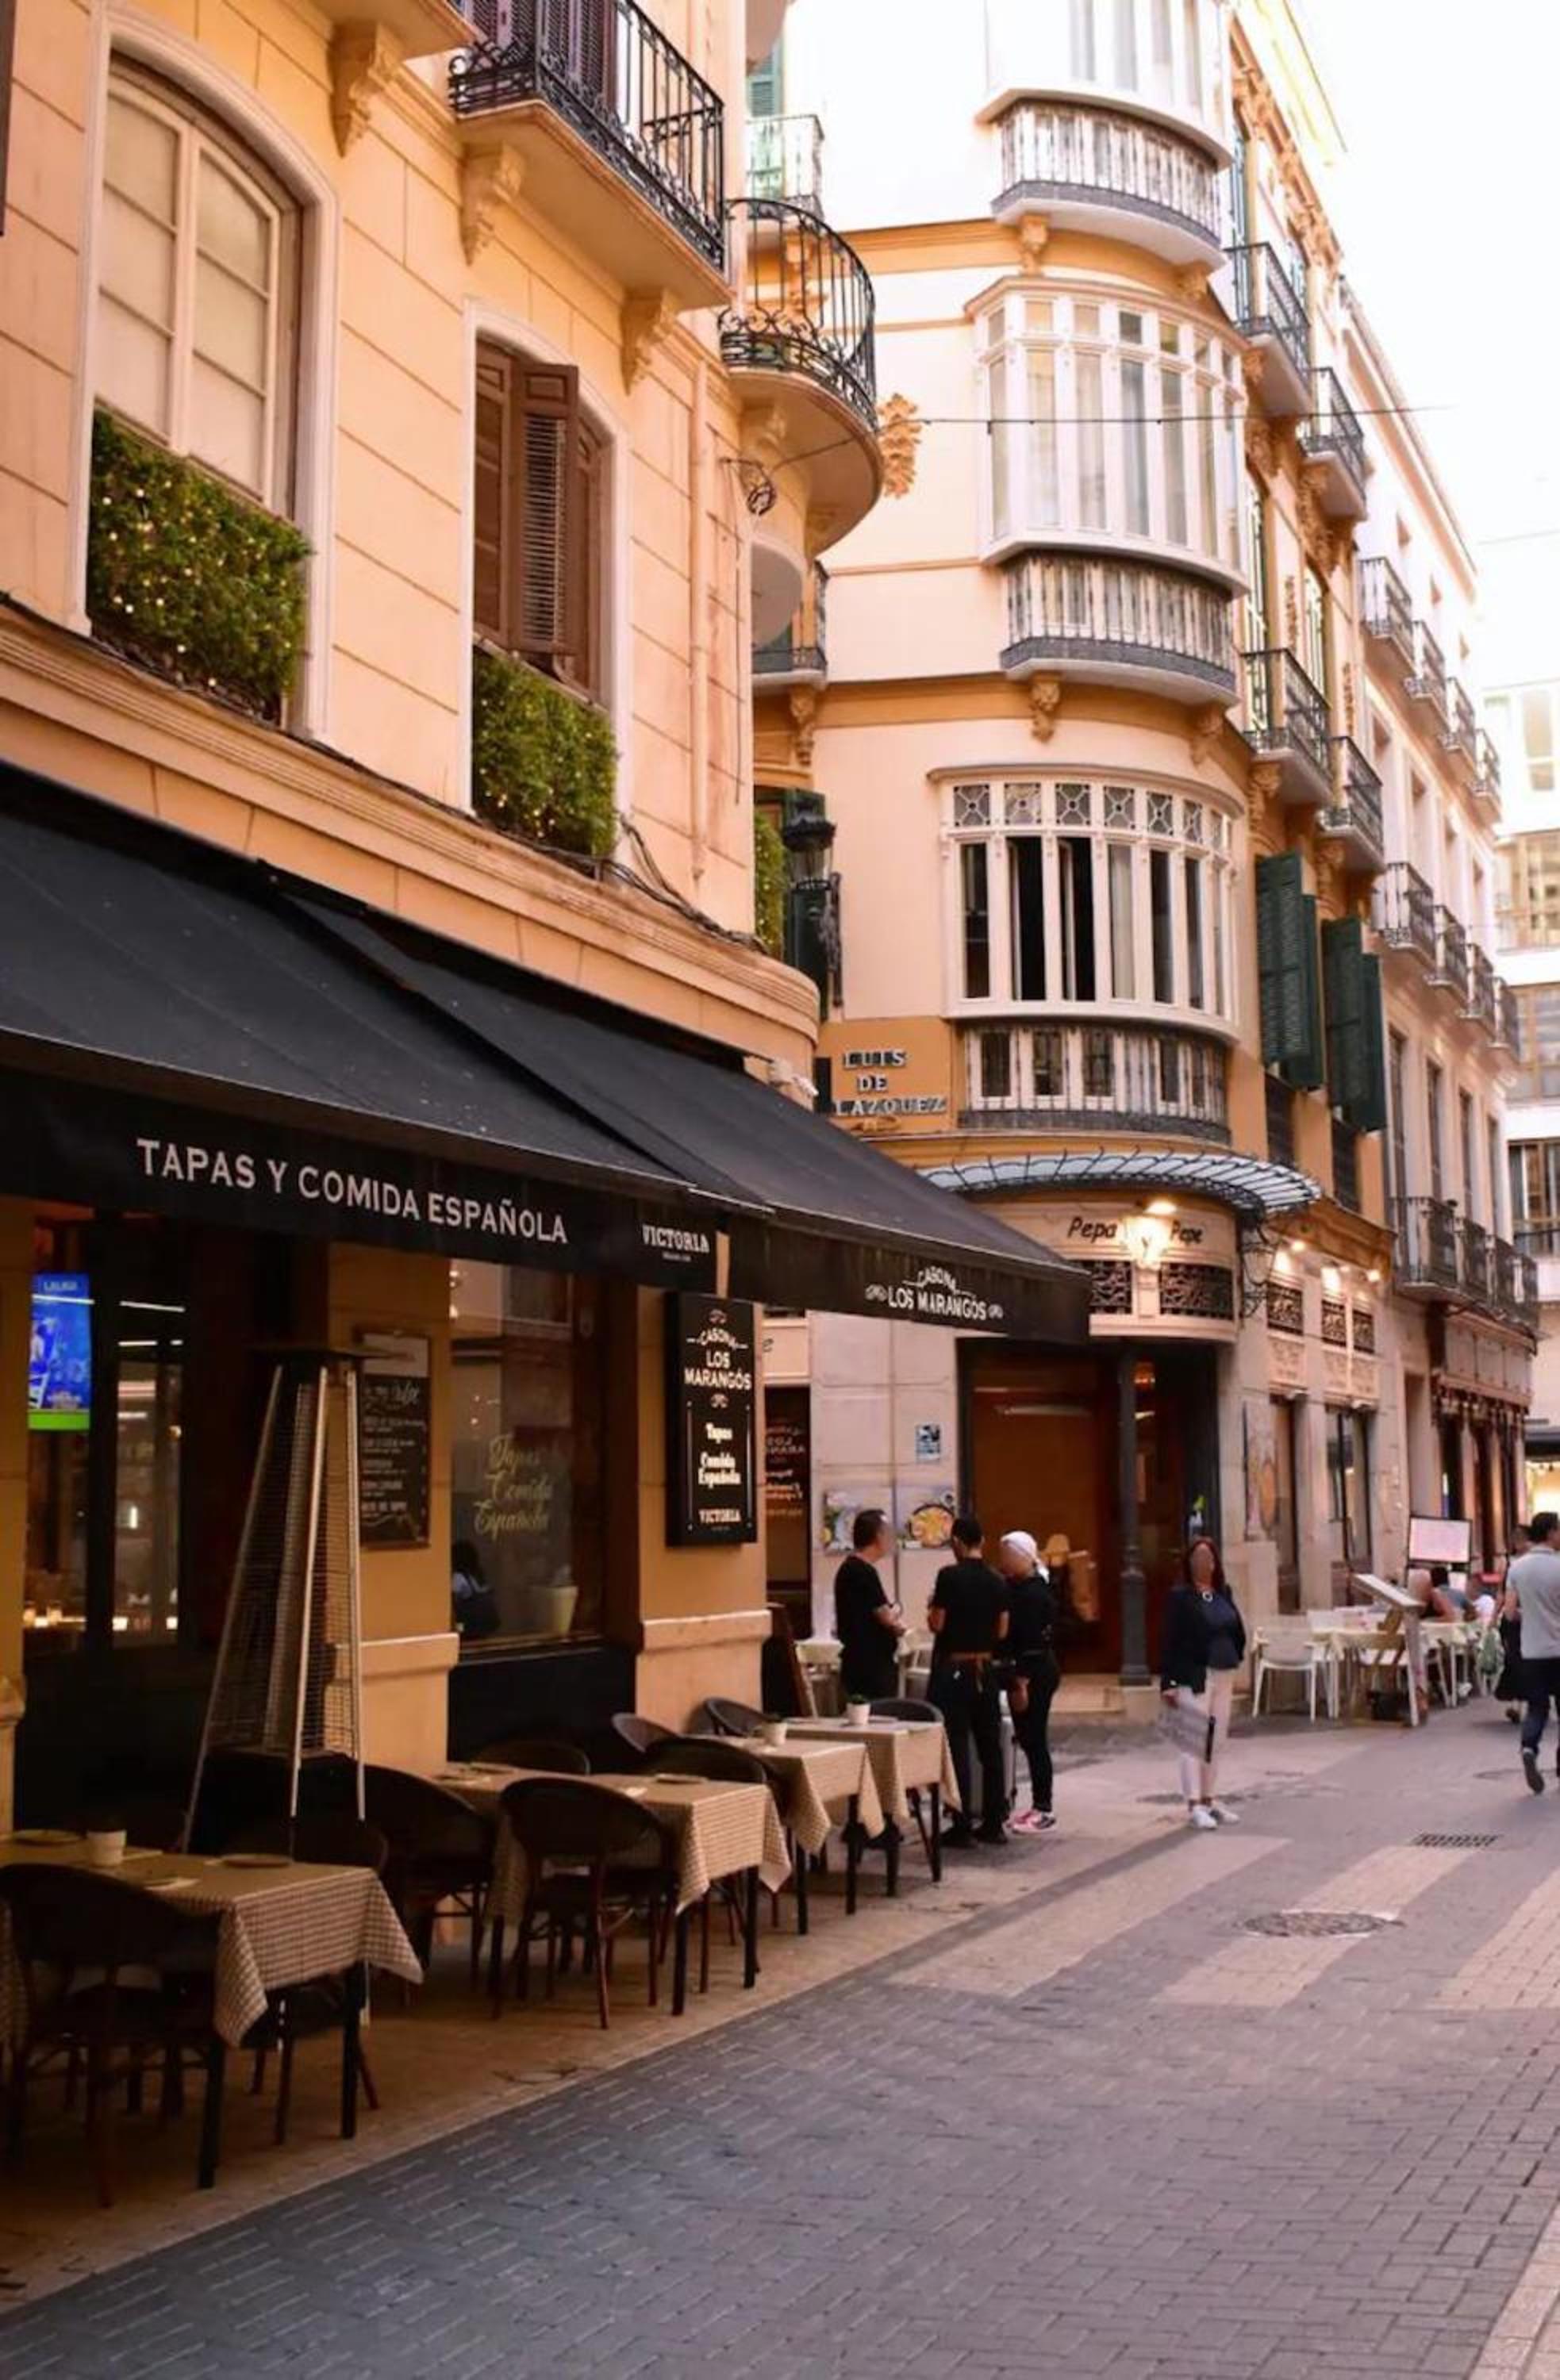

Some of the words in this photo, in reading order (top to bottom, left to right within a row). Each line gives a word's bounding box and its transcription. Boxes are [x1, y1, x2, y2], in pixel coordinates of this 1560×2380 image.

[844, 1048, 907, 1069] LUIS
[858, 1073, 887, 1092] DE
[835, 1096, 947, 1116] LAZQUEZ
[136, 1138, 256, 1188] TAPAS
[267, 1159, 287, 1194] Y
[298, 1166, 420, 1220] COMIDA
[428, 1192, 568, 1244] ESPAÑOLA
[641, 1223, 711, 1253] VICTORIA
[1067, 1216, 1118, 1244] Pepa
[1169, 1219, 1204, 1244] Pepe
[887, 1285, 913, 1309] LOS
[705, 1350, 731, 1369] LOS
[698, 1508, 742, 1523] VICTORIA
